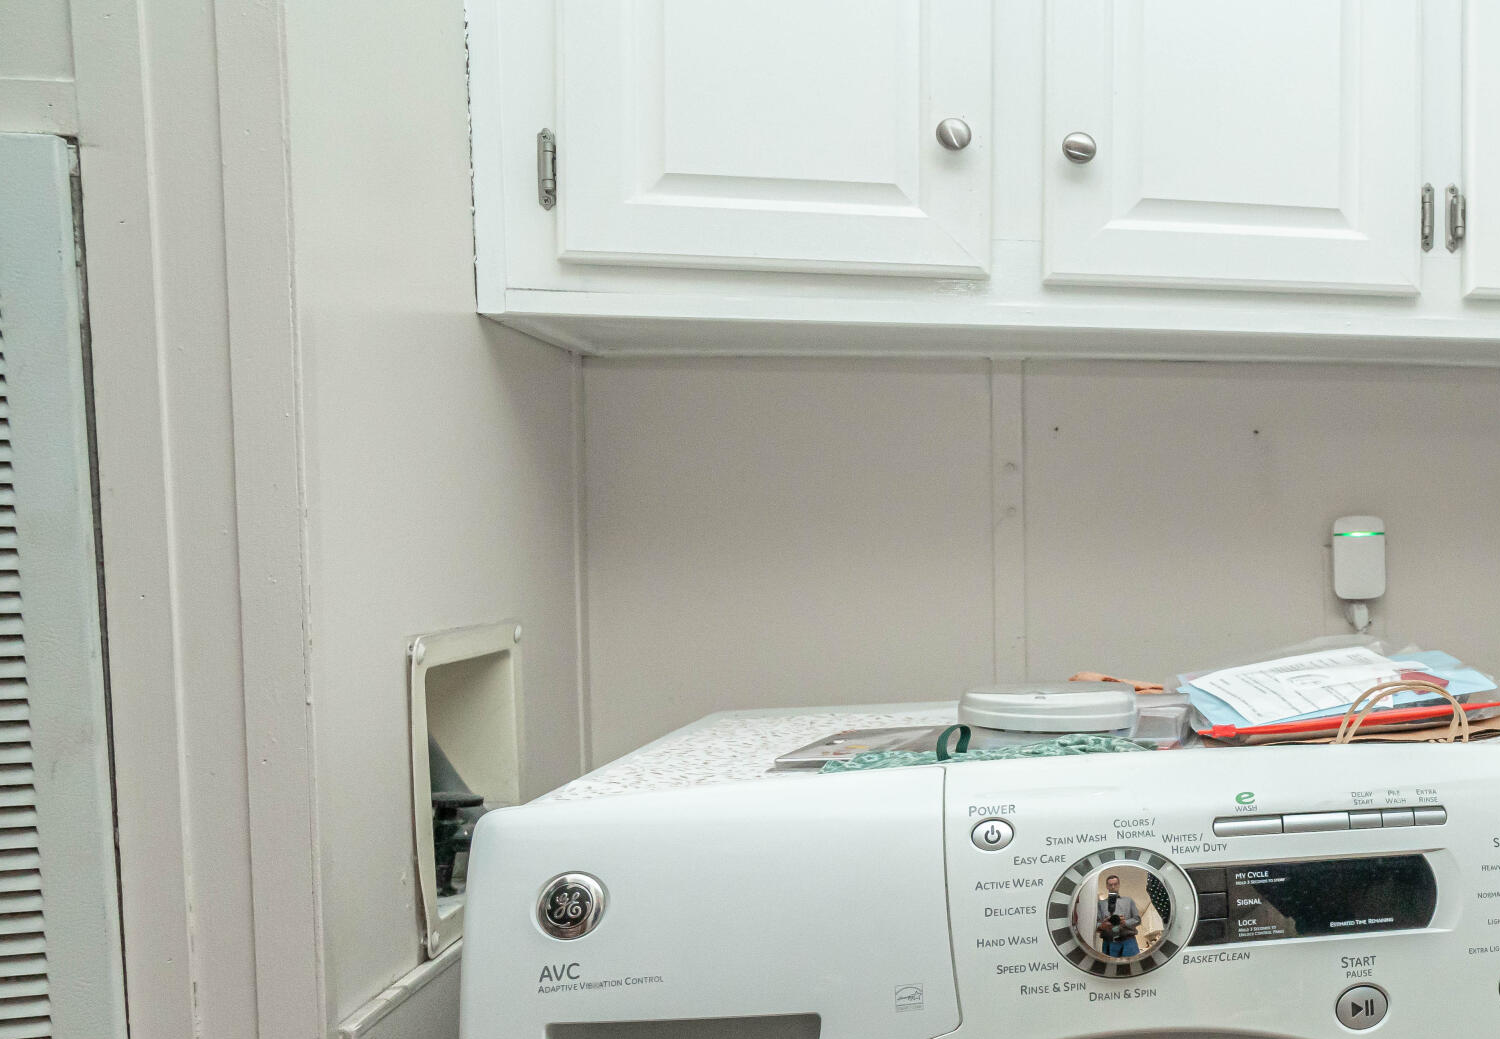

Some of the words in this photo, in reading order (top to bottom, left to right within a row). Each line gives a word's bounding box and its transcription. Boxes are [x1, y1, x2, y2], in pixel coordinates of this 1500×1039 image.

[1416, 788, 1437, 796] EXTRA
[1418, 796, 1439, 804] RINSE
[968, 804, 1016, 817] POWER
[1234, 805, 1258, 813] WASH
[1113, 818, 1149, 828] COLORS
[1045, 836, 1073, 846] STAIN
[1076, 833, 1107, 844] WASH
[1116, 830, 1156, 840] NORMAL
[1162, 834, 1199, 844] WHITES
[1171, 844, 1200, 855] HEAVY
[1203, 842, 1228, 853] DUTY
[1013, 856, 1038, 866] EASY
[1040, 854, 1066, 864] CARE
[975, 880, 1010, 891] ACTIVE
[1012, 878, 1044, 888] WEAR
[1236, 898, 1262, 906] SIGNAL
[984, 905, 1037, 917] DELICATES
[1238, 919, 1257, 927] LOCK
[976, 938, 1006, 948] HAND
[1007, 936, 1038, 946] WASH
[1468, 947, 1489, 955] EXTRA
[1182, 952, 1251, 965] BASKETCLEAN
[1341, 955, 1377, 969] START
[538, 962, 580, 983] AVC
[996, 963, 1026, 975] SPEED
[1028, 962, 1059, 973] WASH
[1346, 968, 1373, 979] PAUSE
[537, 982, 578, 994] ADAPTIVE
[579, 979, 623, 991] VIBATION
[624, 975, 664, 986] CONTROL
[1020, 984, 1050, 995] RINSE
[1052, 982, 1061, 993] &
[1063, 982, 1087, 992] SPIN
[1089, 990, 1121, 1001] DRAIN
[1123, 989, 1132, 999] &
[1134, 988, 1157, 998] SPIN
